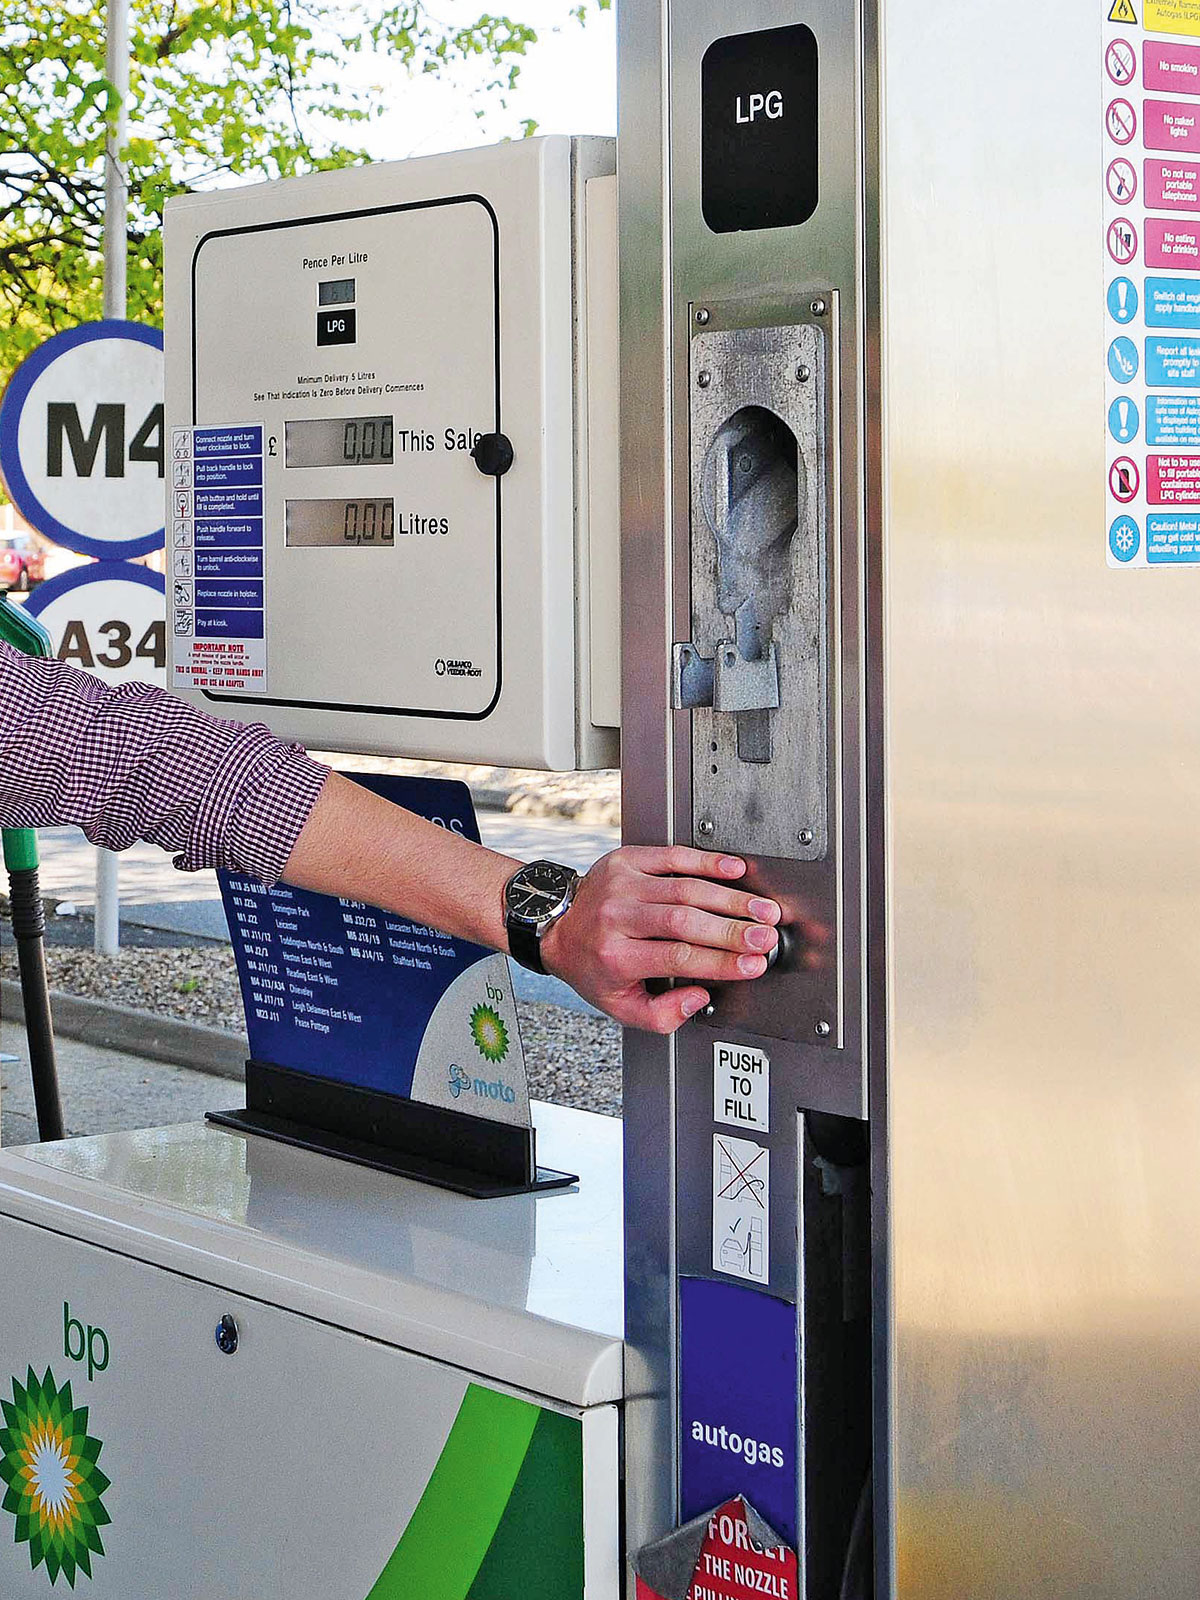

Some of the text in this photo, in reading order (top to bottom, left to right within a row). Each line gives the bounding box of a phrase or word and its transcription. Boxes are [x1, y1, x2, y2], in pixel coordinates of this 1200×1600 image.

[1160, 61, 1198, 76] No smoking
[736, 90, 783, 124] LPG
[1163, 114, 1173, 124] No
[1161, 168, 1171, 177] Do
[1172, 169, 1183, 179] not
[1164, 232, 1174, 242] No
[1161, 244, 1172, 253] No
[303, 252, 368, 269] Pence Per Litre
[327, 320, 345, 333] LPG
[297, 372, 375, 385] Minimum Delivery Litres
[253, 393, 265, 402] See
[267, 392, 280, 400] That
[319, 388, 334, 397] Zero
[336, 387, 356, 396] Before
[358, 385, 382, 396] Delivery
[385, 383, 424, 393] Commences
[195, 436, 218, 444] Connect
[268, 436, 277, 456] £
[399, 427, 482, 452] This Sale
[206, 464, 218, 472] back
[243, 462, 253, 470] lock
[1158, 458, 1170, 467] Not
[196, 495, 208, 503] Push
[1160, 490, 1174, 500] LPG
[196, 525, 208, 533] Push
[399, 513, 449, 535] Litres
[197, 619, 207, 627] Pay
[57, 620, 165, 669] A34
[233, 897, 242, 906] M1
[237, 912, 246, 922] M1
[241, 928, 250, 938] M1
[486, 982, 503, 1004] bp
[719, 1049, 762, 1074] PUSH
[474, 1078, 515, 1103] moto
[730, 1076, 751, 1096] TO
[725, 1098, 757, 1122] FILL
[63, 1301, 109, 1381] bp
[692, 1421, 784, 1467] autogas
[703, 1553, 731, 1581] THE
[734, 1563, 789, 1600] NOZZLE
